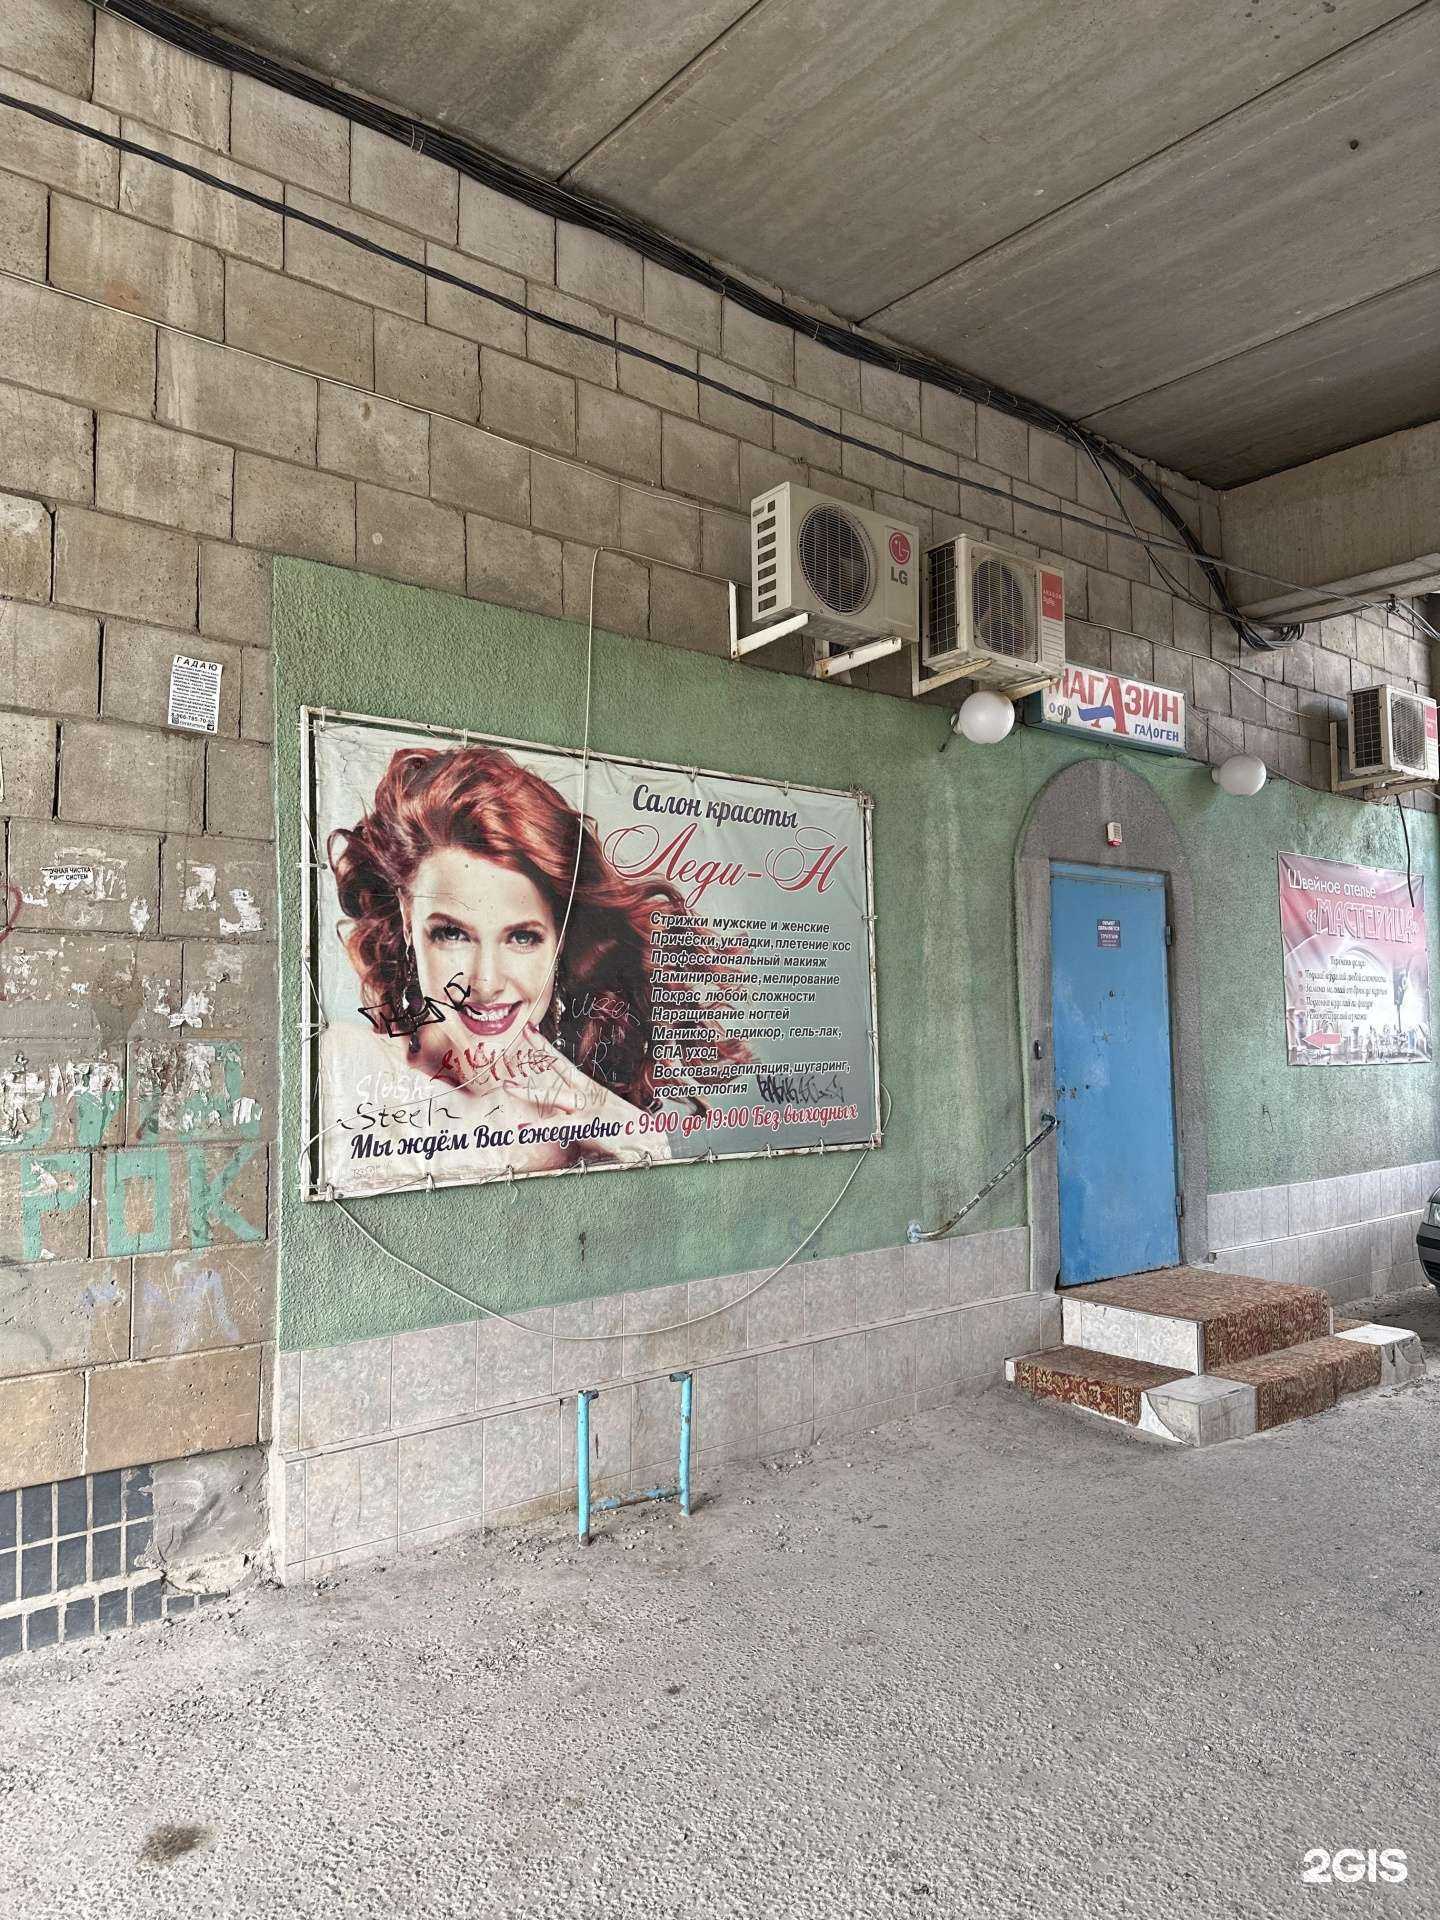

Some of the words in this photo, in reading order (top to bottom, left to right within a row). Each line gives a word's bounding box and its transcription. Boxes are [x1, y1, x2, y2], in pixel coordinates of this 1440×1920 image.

[890, 566, 908, 586] LG
[176, 656, 218, 671] ГАДАЮ
[1049, 668, 1179, 735] МАГАЗИН
[1134, 723, 1179, 742] ГАЛОГЕН
[633, 784, 702, 818] Салон
[705, 801, 799, 829] красоты
[1287, 868, 1341, 896] Швейное
[651, 912, 709, 929] Стрижки
[712, 917, 767, 930] мужские
[770, 922, 778, 931] и
[780, 922, 830, 933] женские
[775, 939, 829, 949] плетение
[832, 941, 851, 951] кос
[651, 950, 780, 966] Профессиональный
[783, 958, 827, 967] макияж
[650, 969, 761, 985] Ламинирование,
[762, 975, 840, 986] мелирование
[652, 988, 700, 1004] Покрас
[704, 989, 747, 1001] любой
[752, 992, 816, 1001] сложности
[652, 1007, 744, 1023] Наращивание
[748, 1008, 790, 1020] ногтей
[652, 1027, 721, 1042] Маникюр,
[725, 1028, 784, 1040] педикюр,
[789, 1026, 842, 1039] гель-лак,
[653, 1045, 682, 1059] СПА
[686, 1047, 718, 1061] уход
[794, 1061, 850, 1074] шугаринг,
[654, 1083, 748, 1098] косметология
[351, 1134, 393, 1159] Мы
[397, 1129, 469, 1160] ждём
[474, 1124, 514, 1149] Вас
[518, 1117, 623, 1147] ежедневно
[625, 1121, 635, 1136] с
[639, 1113, 679, 1134] 9:00
[682, 1116, 701, 1137] до
[706, 1108, 748, 1130] 19:00
[752, 1106, 781, 1130] Без
[784, 1104, 858, 1127] выходных
